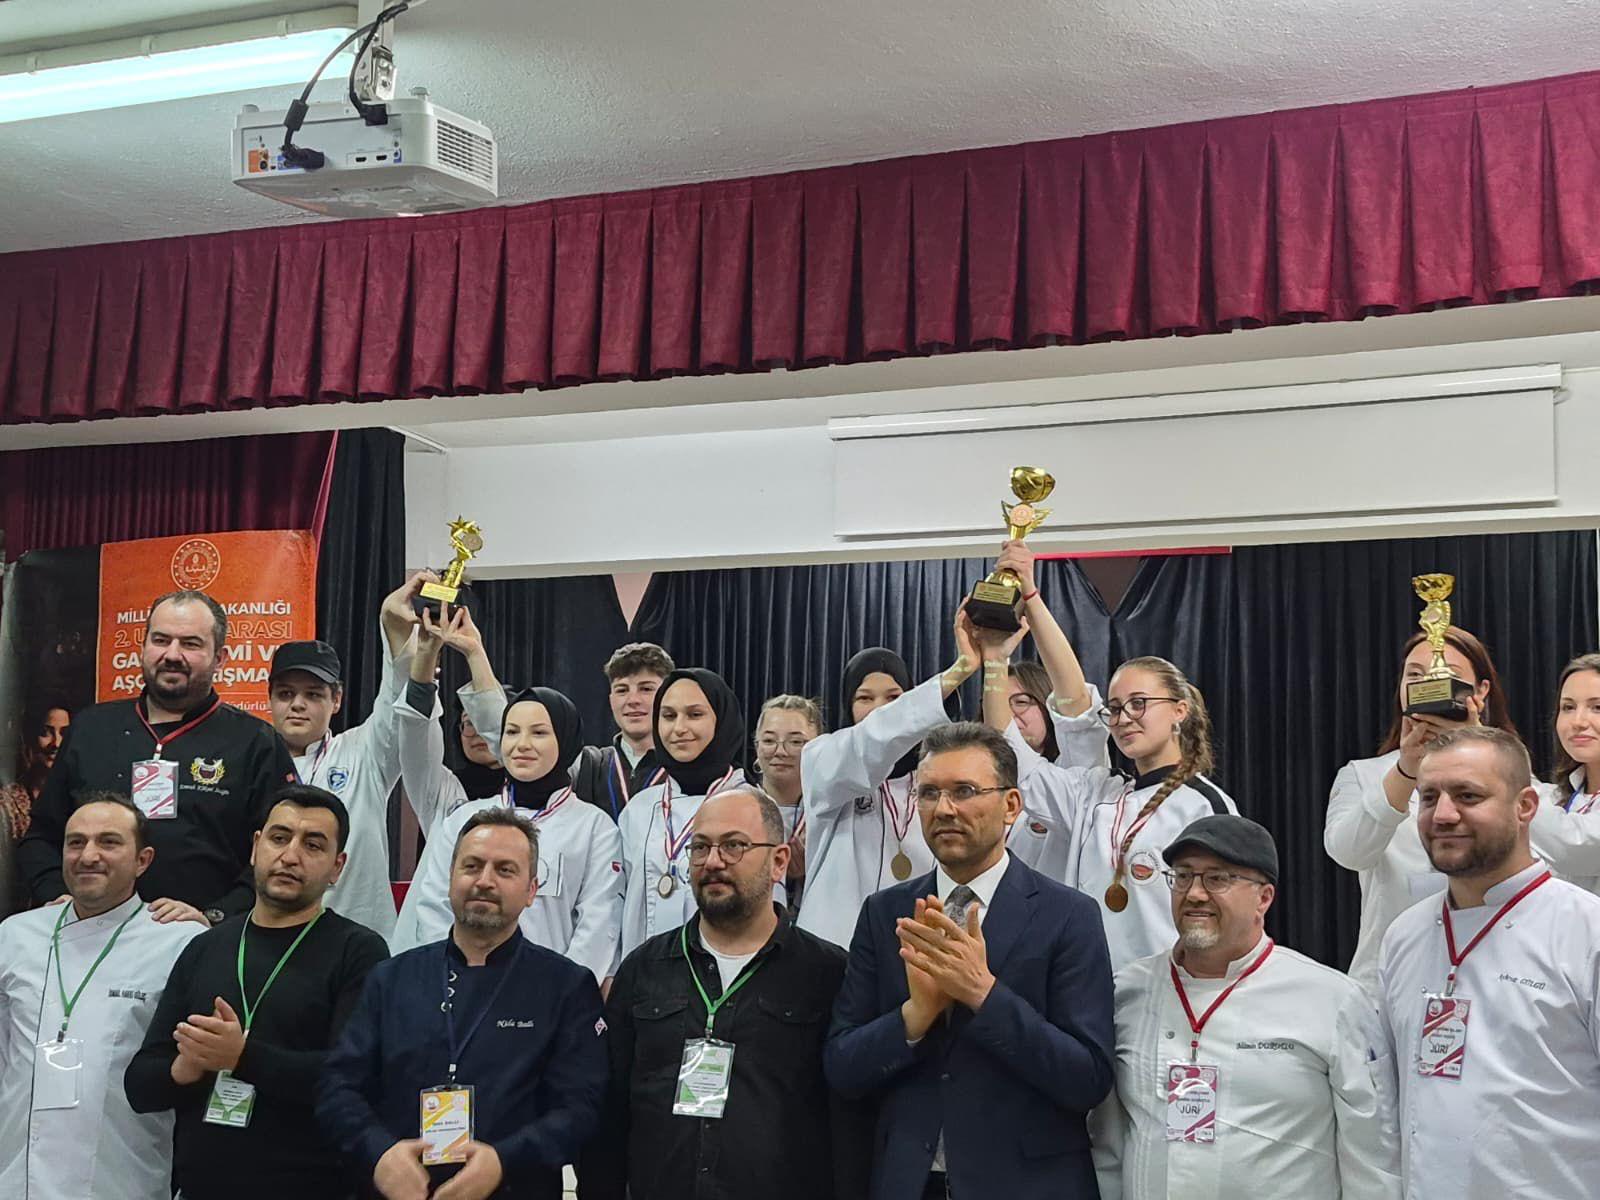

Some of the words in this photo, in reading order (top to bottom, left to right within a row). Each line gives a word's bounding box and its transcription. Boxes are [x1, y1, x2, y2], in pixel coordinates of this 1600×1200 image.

[220, 600, 291, 615] AKANLIĞI
[115, 629, 131, 648] 2.
[224, 620, 293, 639] ARASI
[112, 652, 143, 670] GA
[222, 640, 252, 661] Mİ
[257, 644, 280, 661] V
[112, 674, 146, 695] AŞÇ
[212, 667, 270, 687] IŞMA
